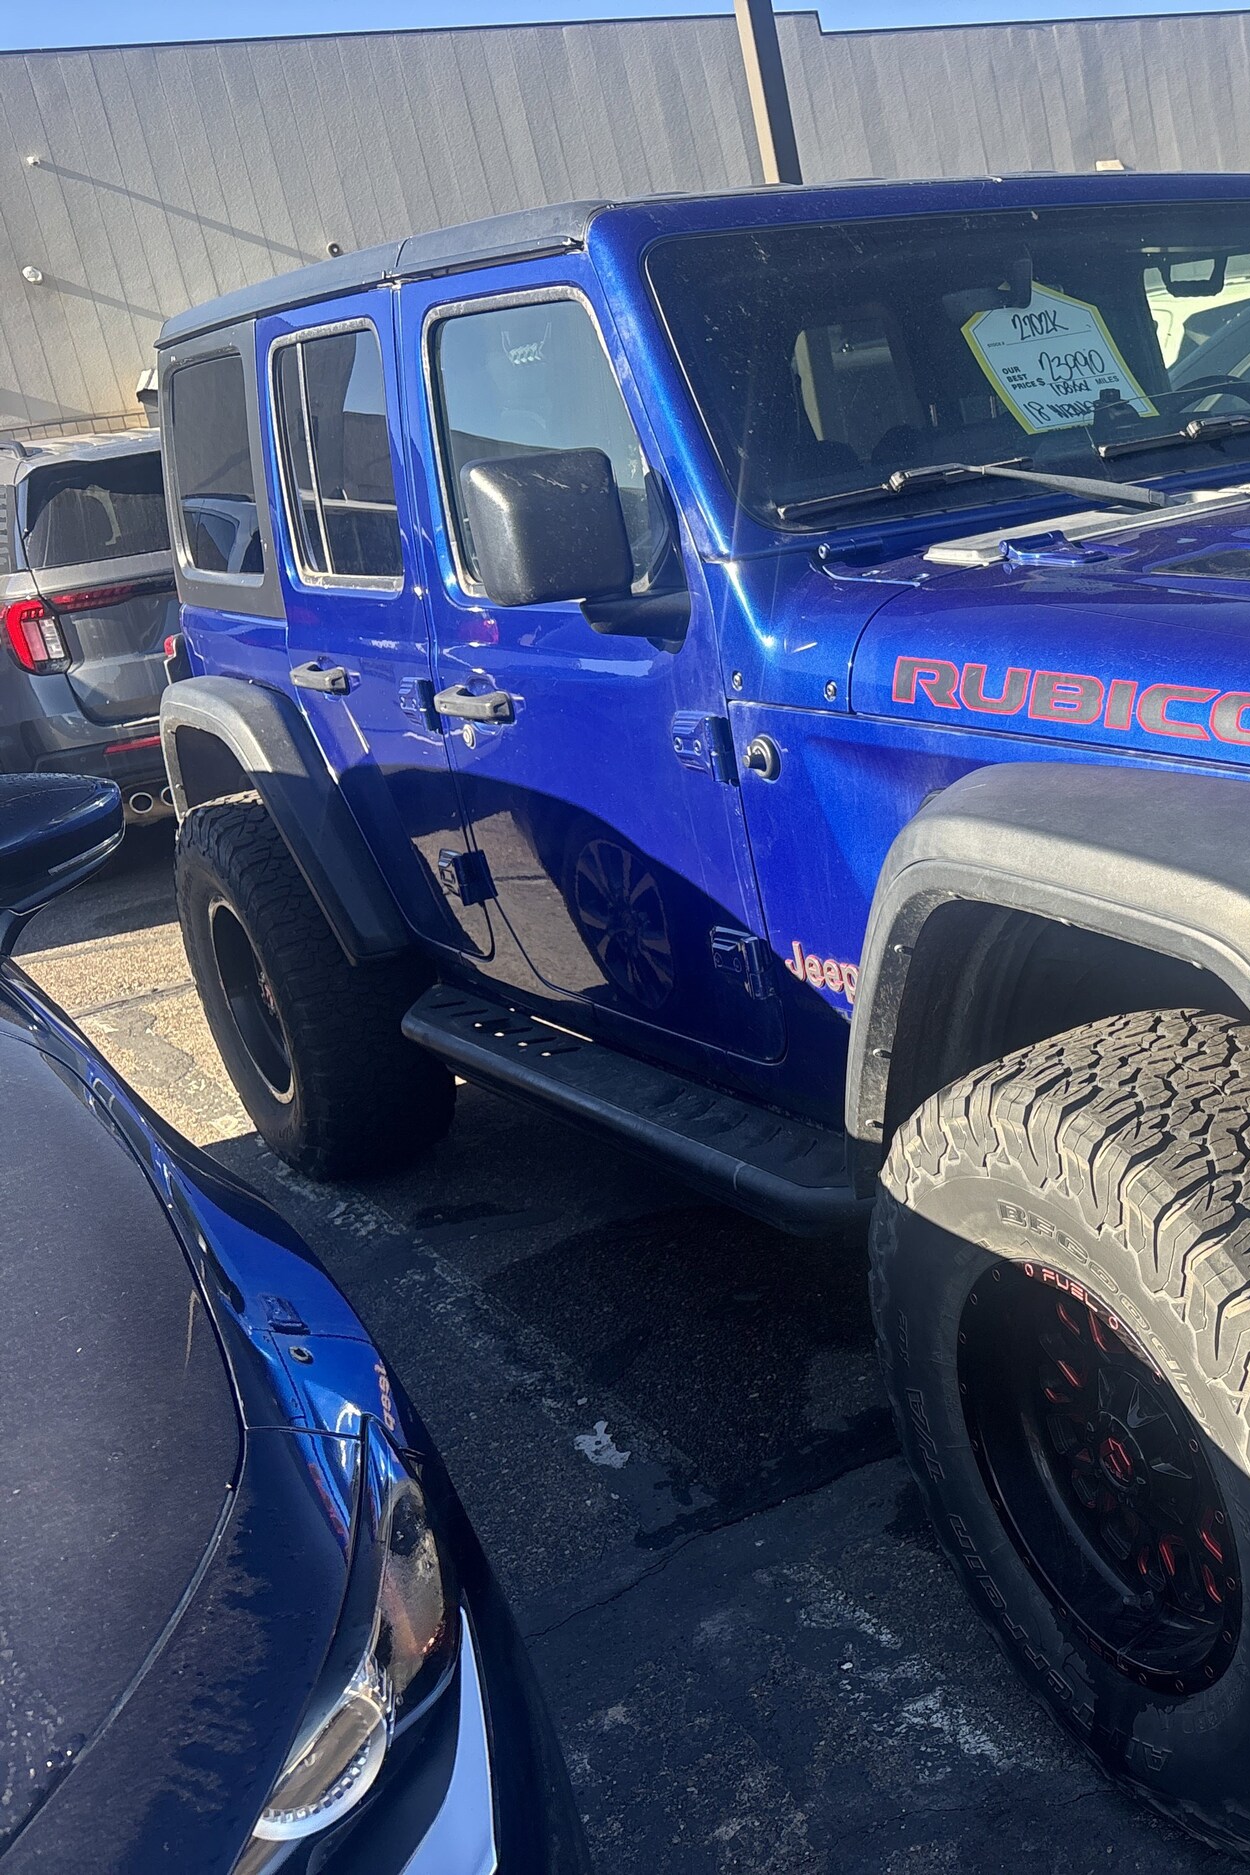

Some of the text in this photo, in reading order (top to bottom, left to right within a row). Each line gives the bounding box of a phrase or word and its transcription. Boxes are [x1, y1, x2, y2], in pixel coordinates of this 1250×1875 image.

[1002, 366, 1021, 375] OUR
[1006, 373, 1028, 383] BEST
[1011, 377, 1046, 391] PRICE $
[1094, 375, 1120, 385] MILES
[784, 940, 860, 1005] Jeep
[1041, 1267, 1099, 1313] FUEL
